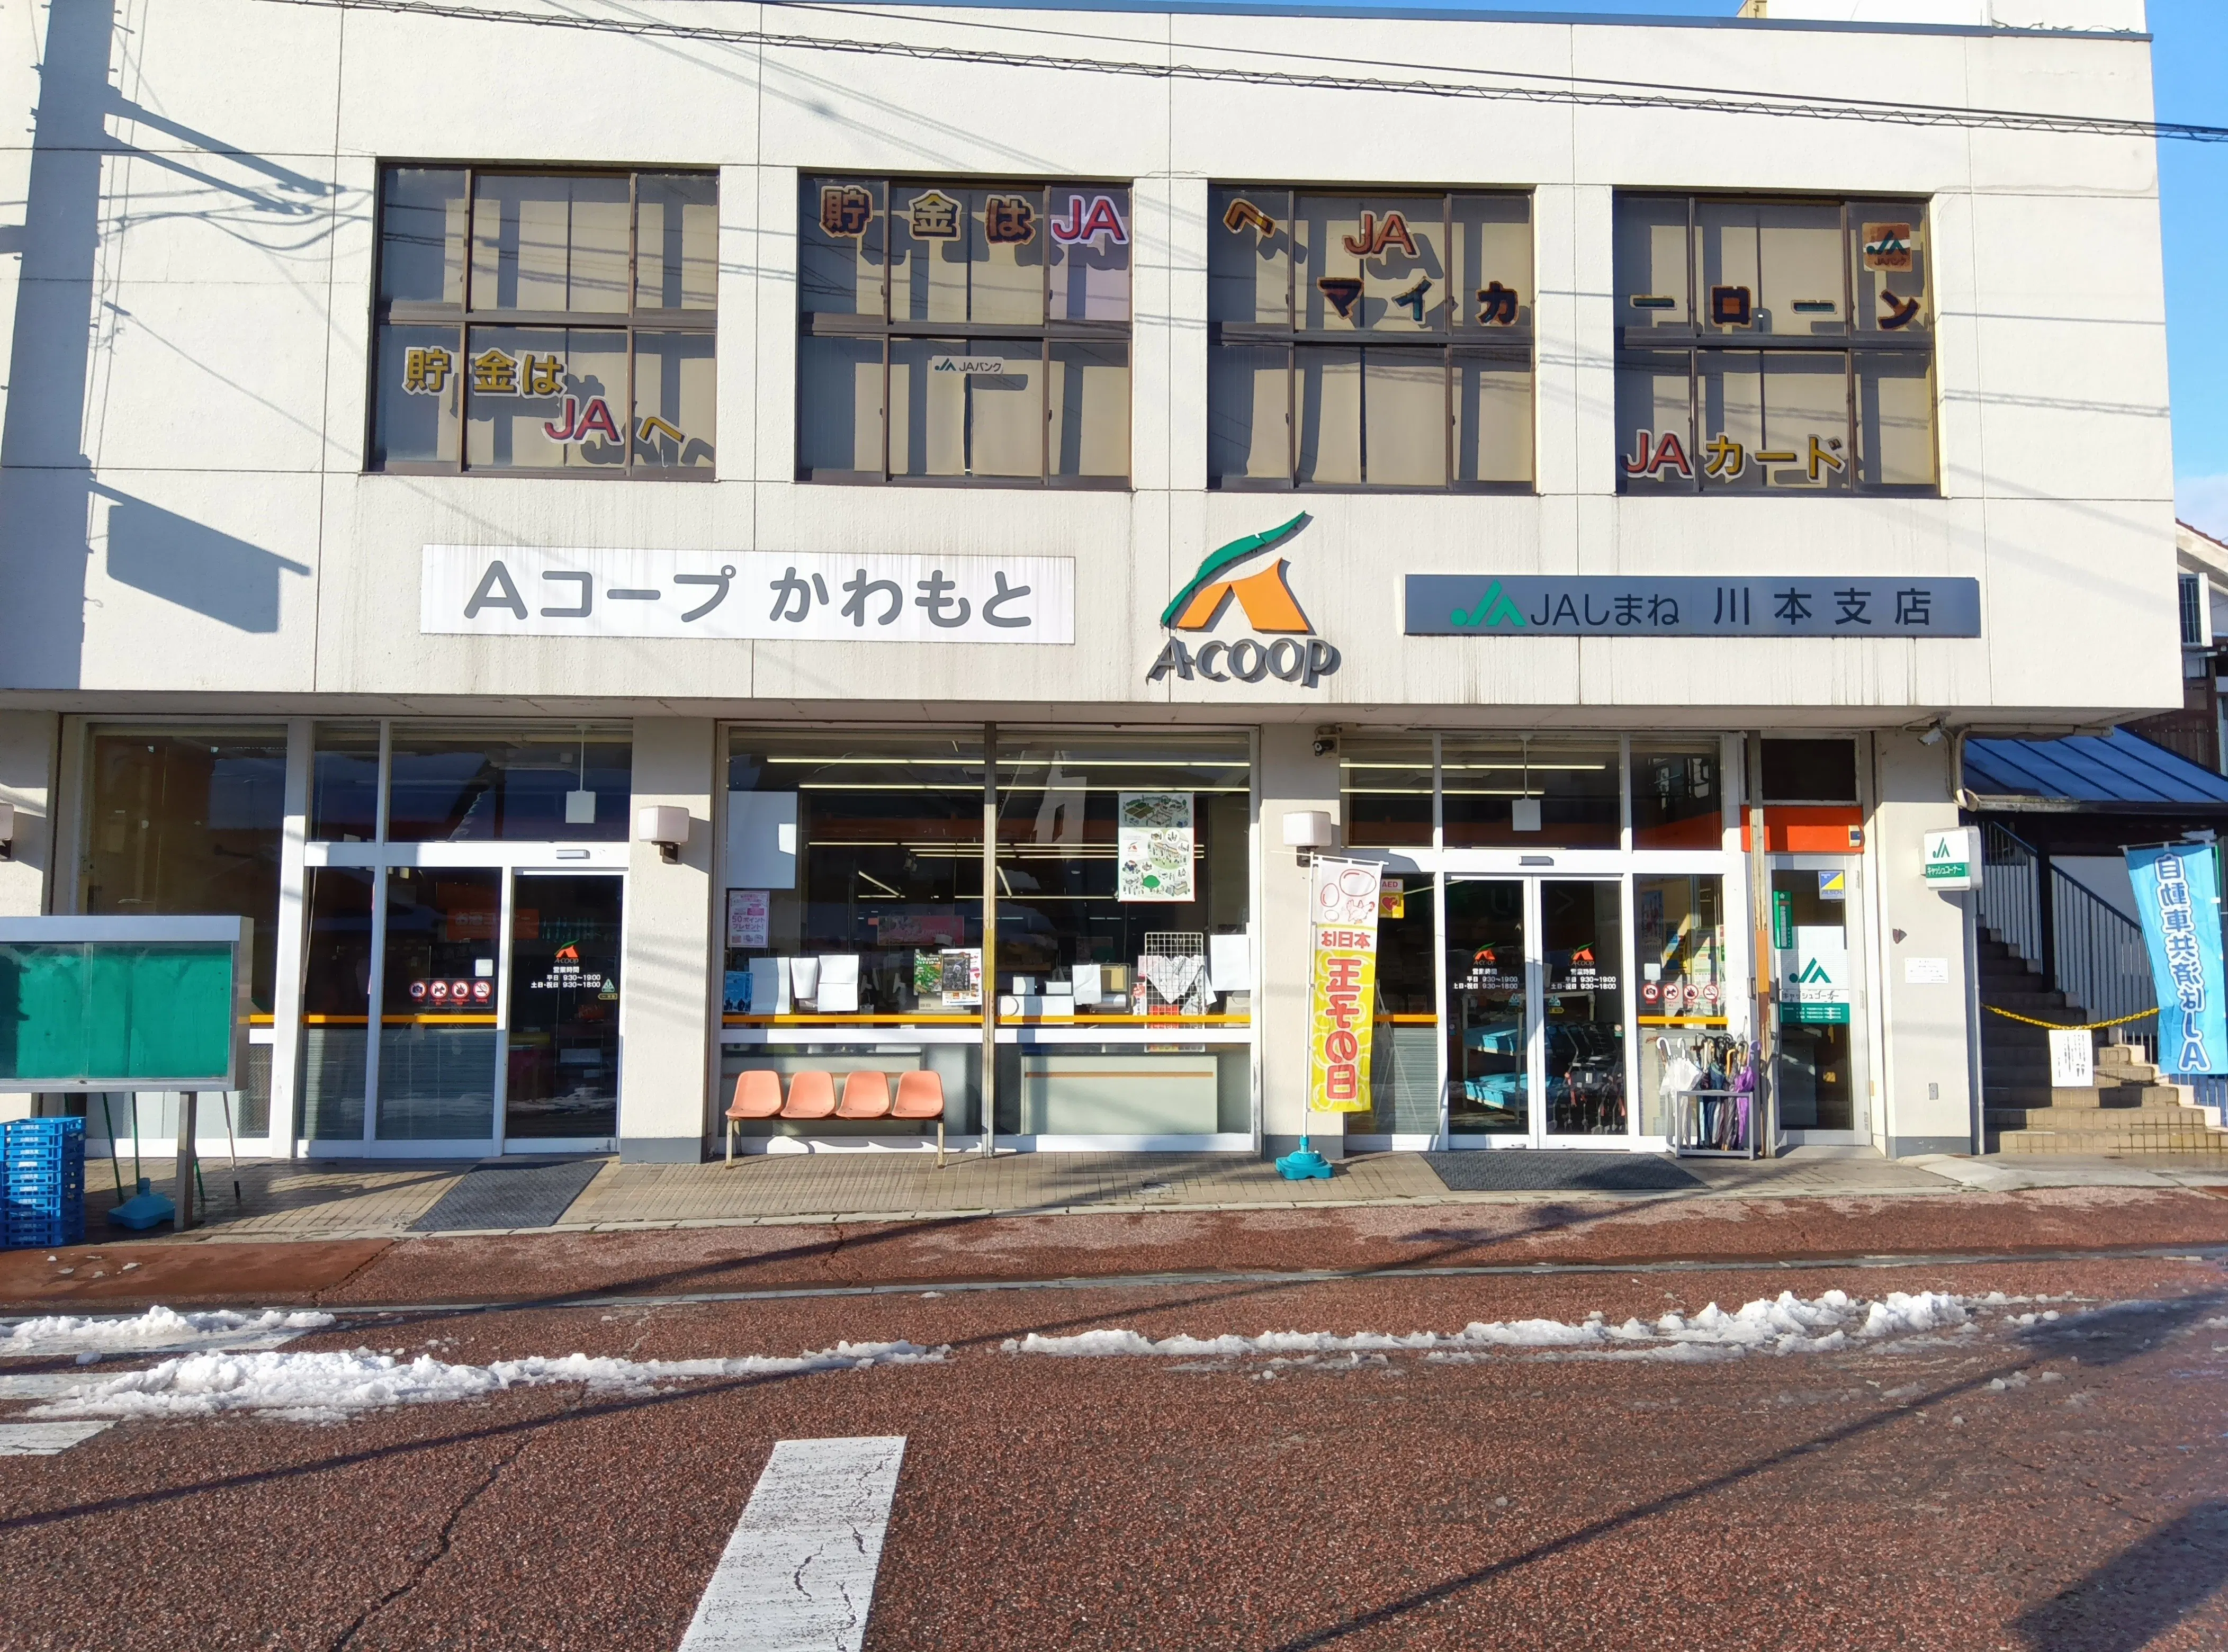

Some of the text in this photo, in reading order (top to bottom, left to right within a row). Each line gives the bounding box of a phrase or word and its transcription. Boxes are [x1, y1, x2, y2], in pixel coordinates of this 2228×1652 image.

[1342, 210, 1420, 258] JA
[405, 348, 567, 396] 貯金は
[959, 361, 1001, 373] JAバンク
[464, 560, 1031, 628] Aコープ かわもと
[1531, 594, 1679, 626] JAしまね
[1714, 587, 1930, 626] 川本支店
[1927, 865, 1962, 876] キャッシュコーナー
